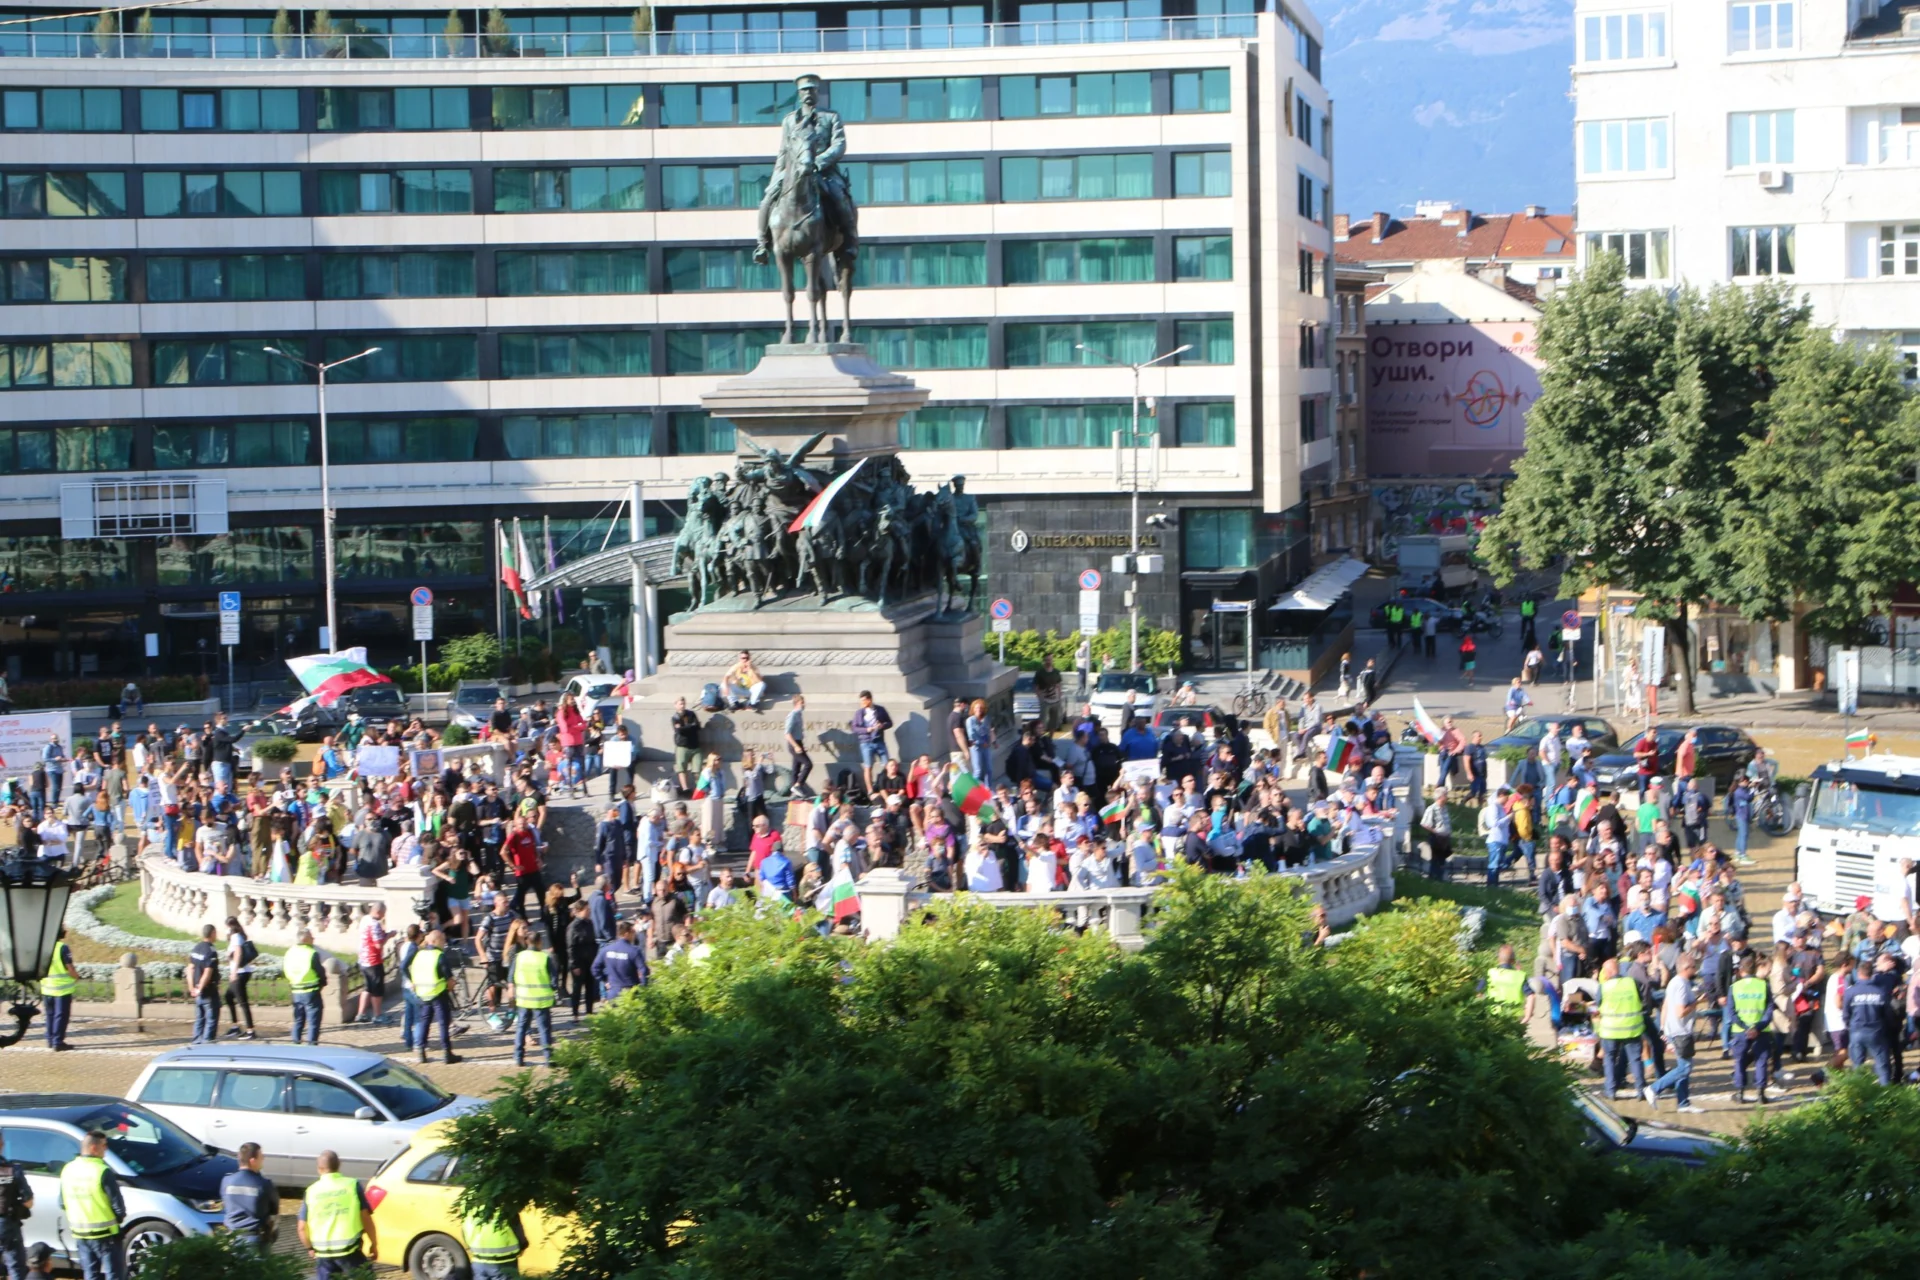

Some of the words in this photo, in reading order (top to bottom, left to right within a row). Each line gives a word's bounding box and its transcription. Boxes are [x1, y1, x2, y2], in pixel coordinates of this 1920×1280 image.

[1371, 336, 1473, 362] Отвори
[1371, 364, 1435, 388] уши.
[1032, 534, 1158, 548] INTERCONTINENAL
